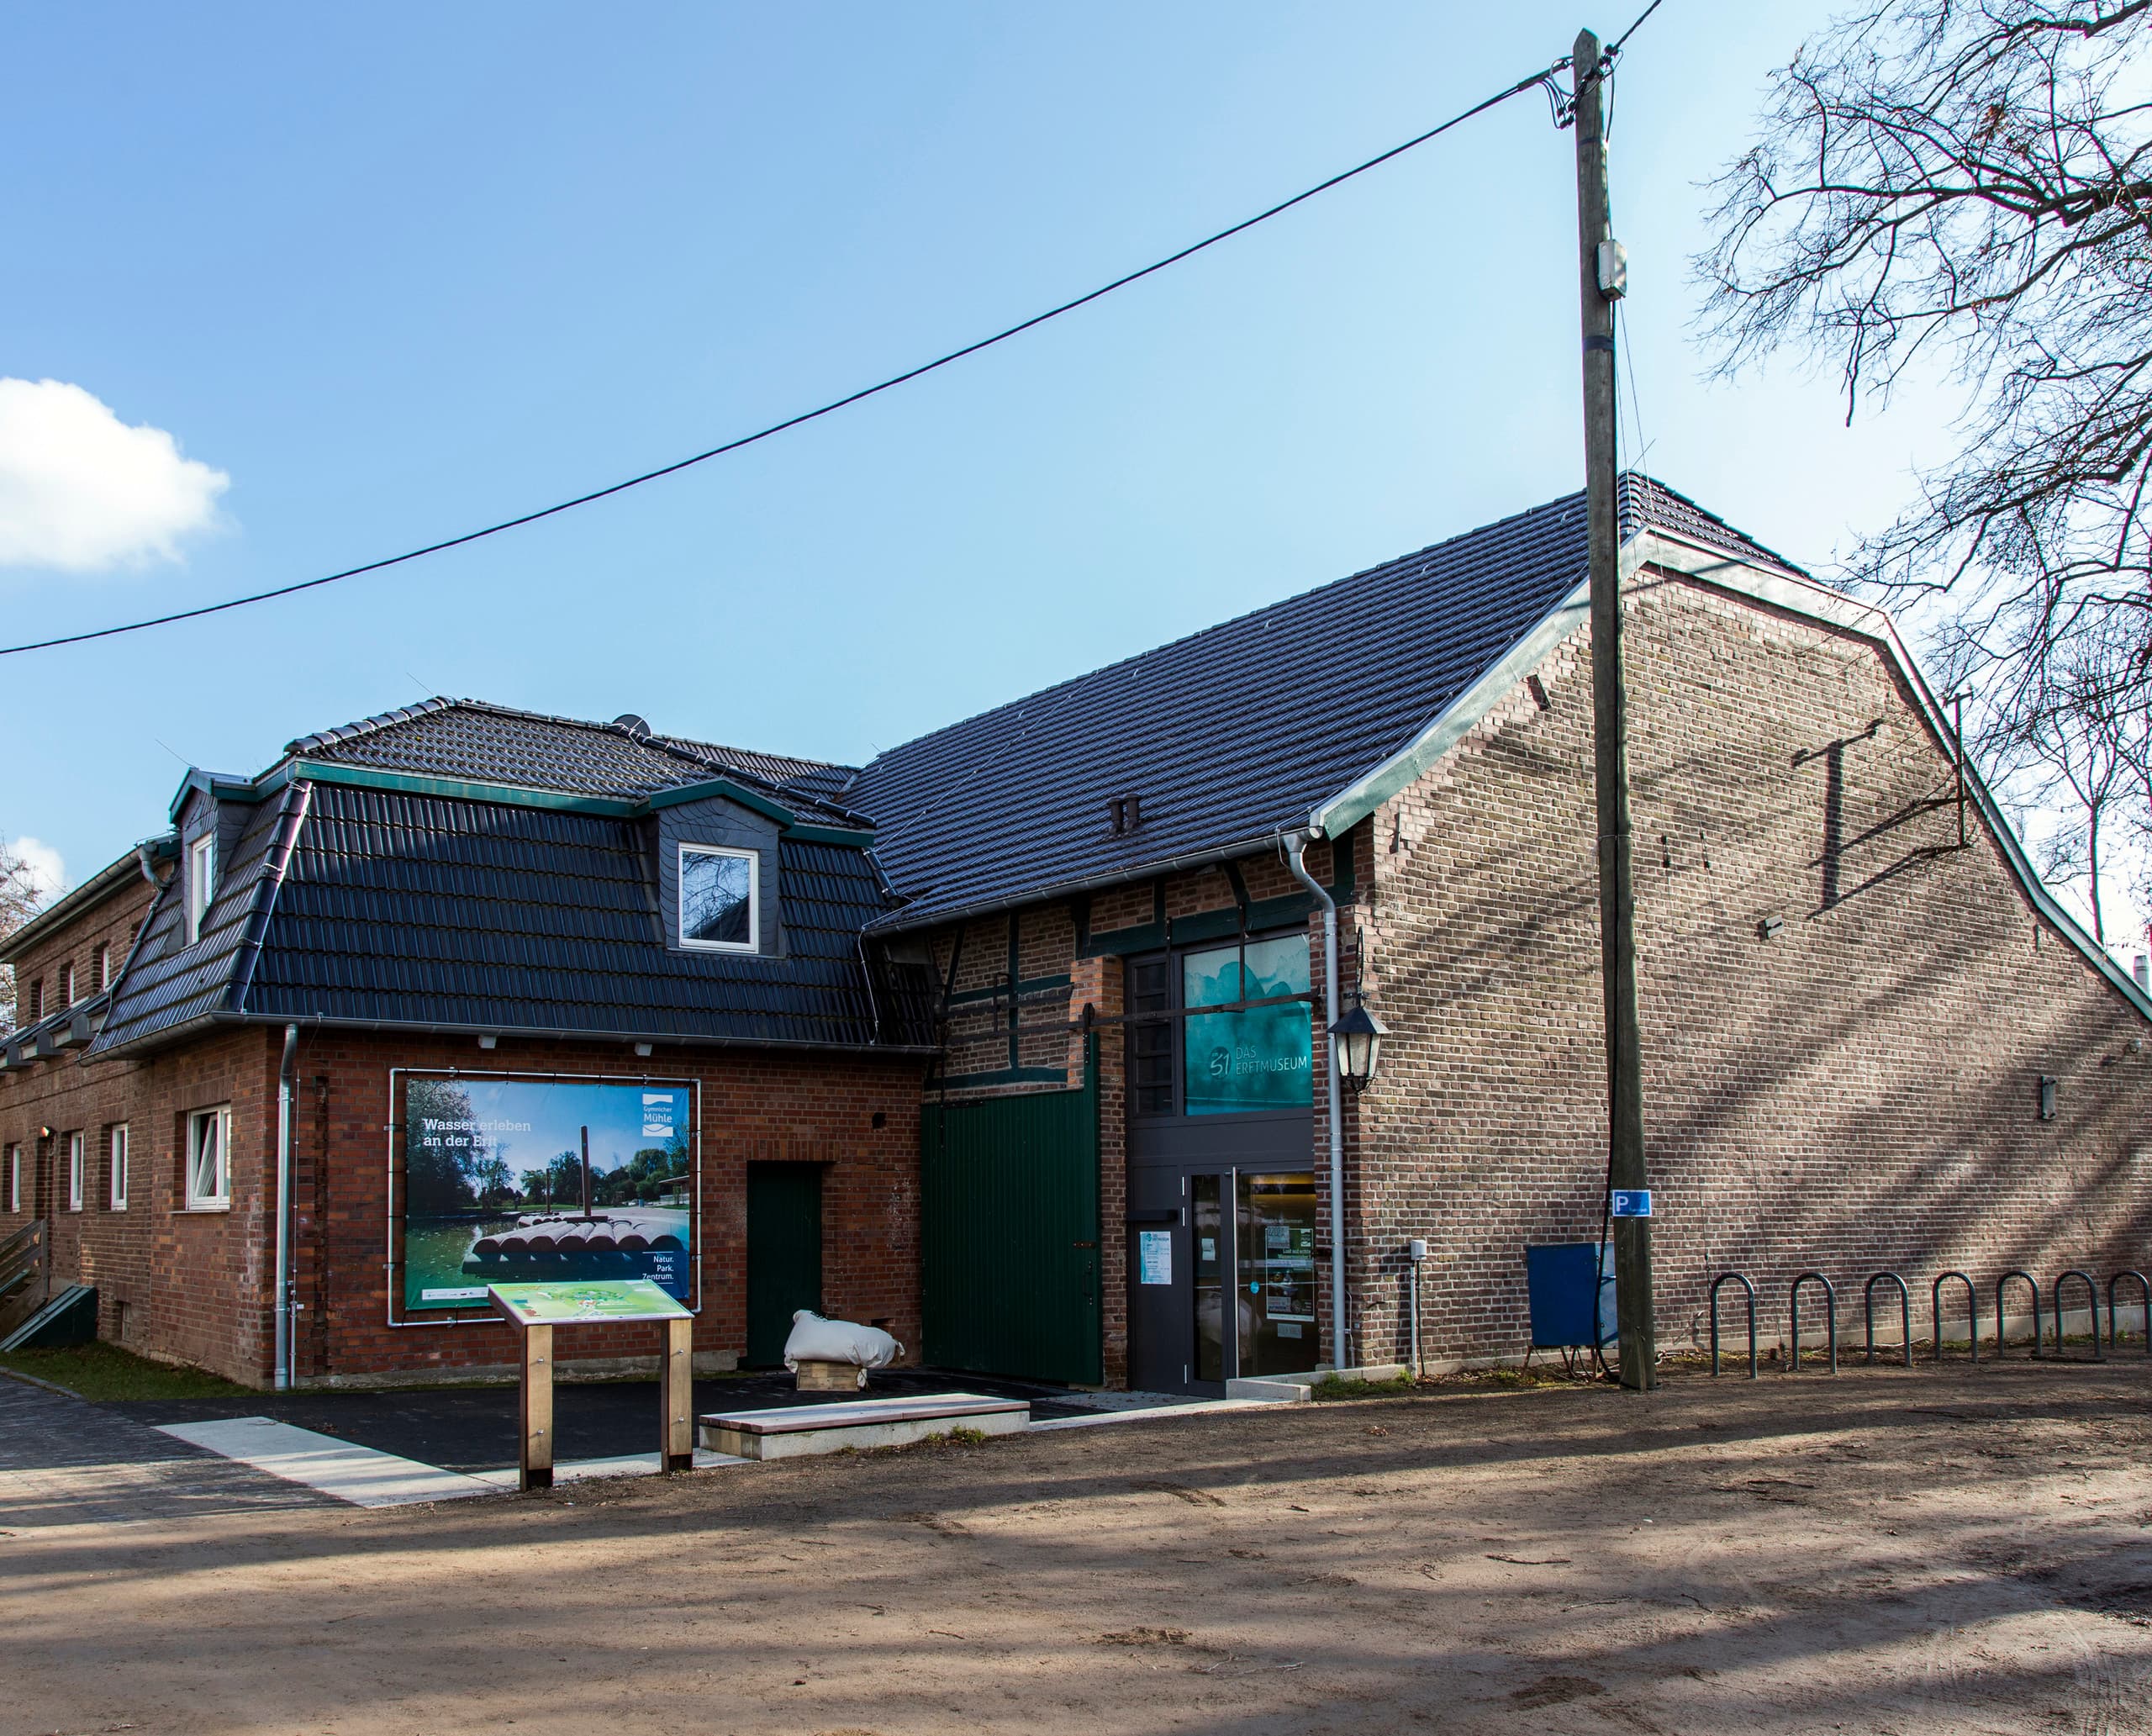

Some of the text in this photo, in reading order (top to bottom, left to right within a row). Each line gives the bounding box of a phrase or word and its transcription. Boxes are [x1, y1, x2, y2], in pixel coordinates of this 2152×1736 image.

[1236, 1046, 1257, 1059] DAS
[1210, 1053, 1230, 1076] 51
[1236, 1056, 1307, 1075] ERFTMUSEUM
[422, 1118, 531, 1132] Wasser erleben
[644, 1113, 672, 1123] Mühle
[423, 1135, 498, 1147] an der Erft
[1616, 1195, 1629, 1212] P
